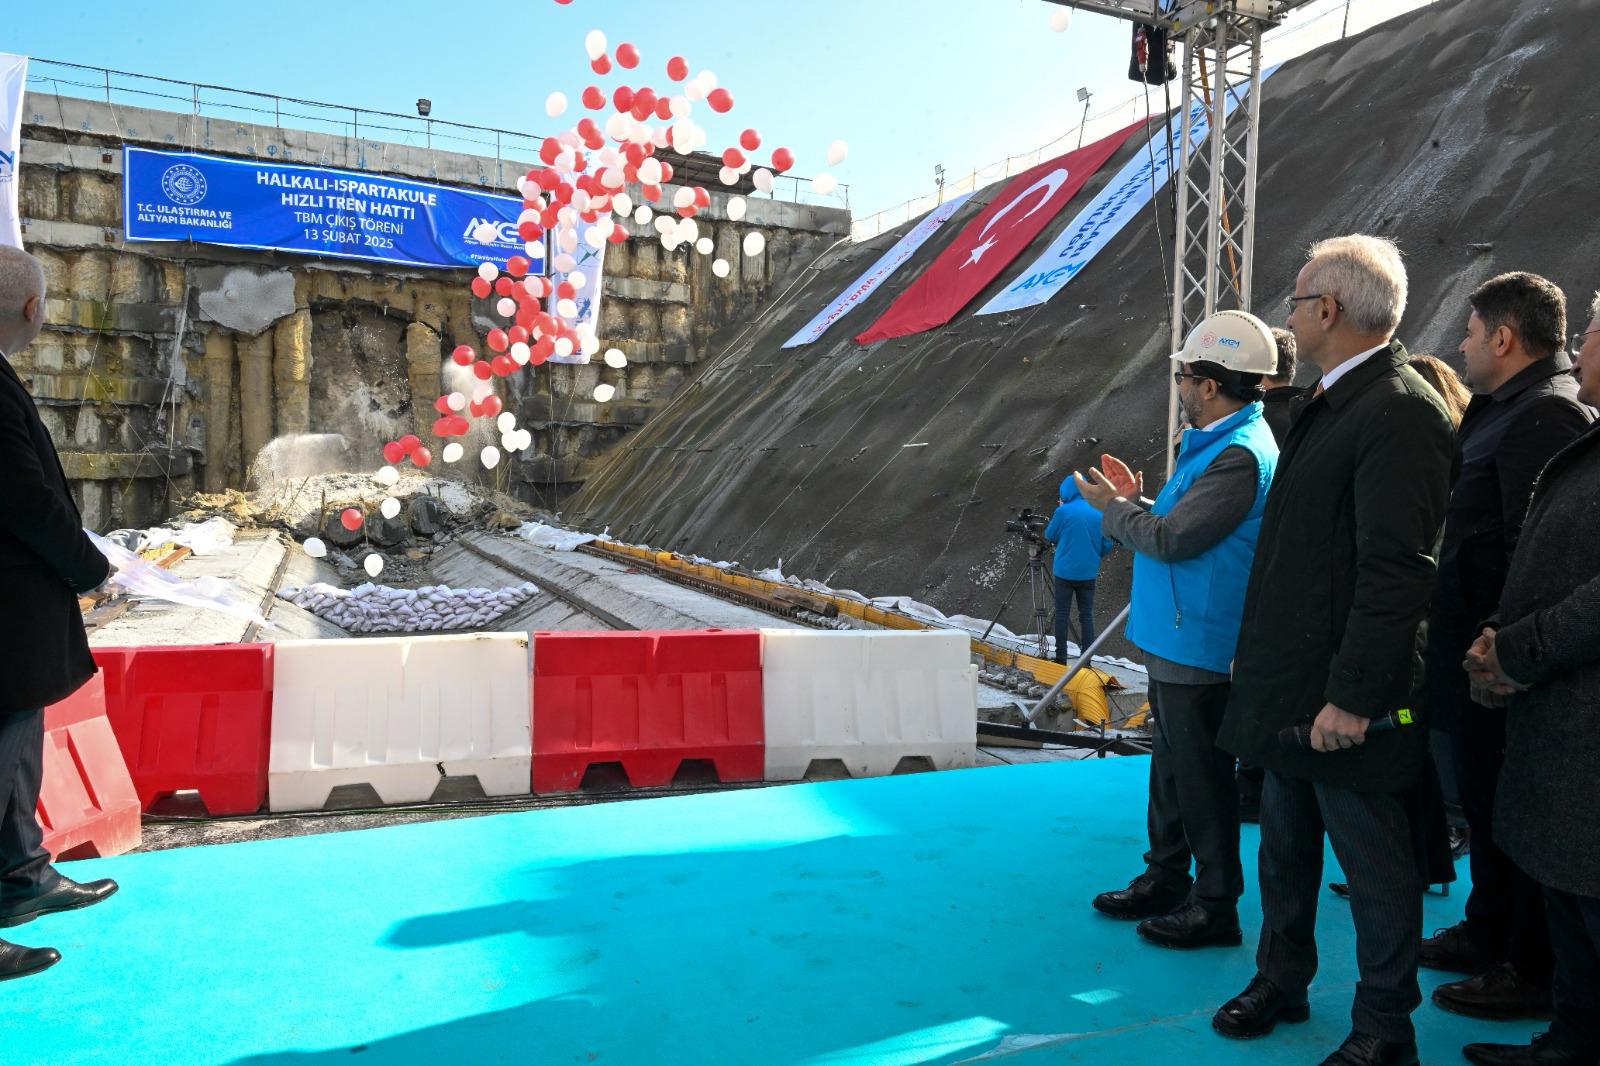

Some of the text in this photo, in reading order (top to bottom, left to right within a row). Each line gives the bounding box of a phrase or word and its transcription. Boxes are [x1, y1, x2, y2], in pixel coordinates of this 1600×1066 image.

[256, 171, 437, 206] HALKALI-ISPARTAKULE
[138, 203, 231, 220] T.C. ULAŞTIRMA VE
[281, 193, 415, 220] HIZLI TREN HATTI
[138, 214, 232, 229] ALTYAPI BAKANLIĞI
[294, 212, 404, 235] TBM ÇIKIŞ TÖRENİ
[303, 228, 394, 249] 13 ŞUBAT 2025
